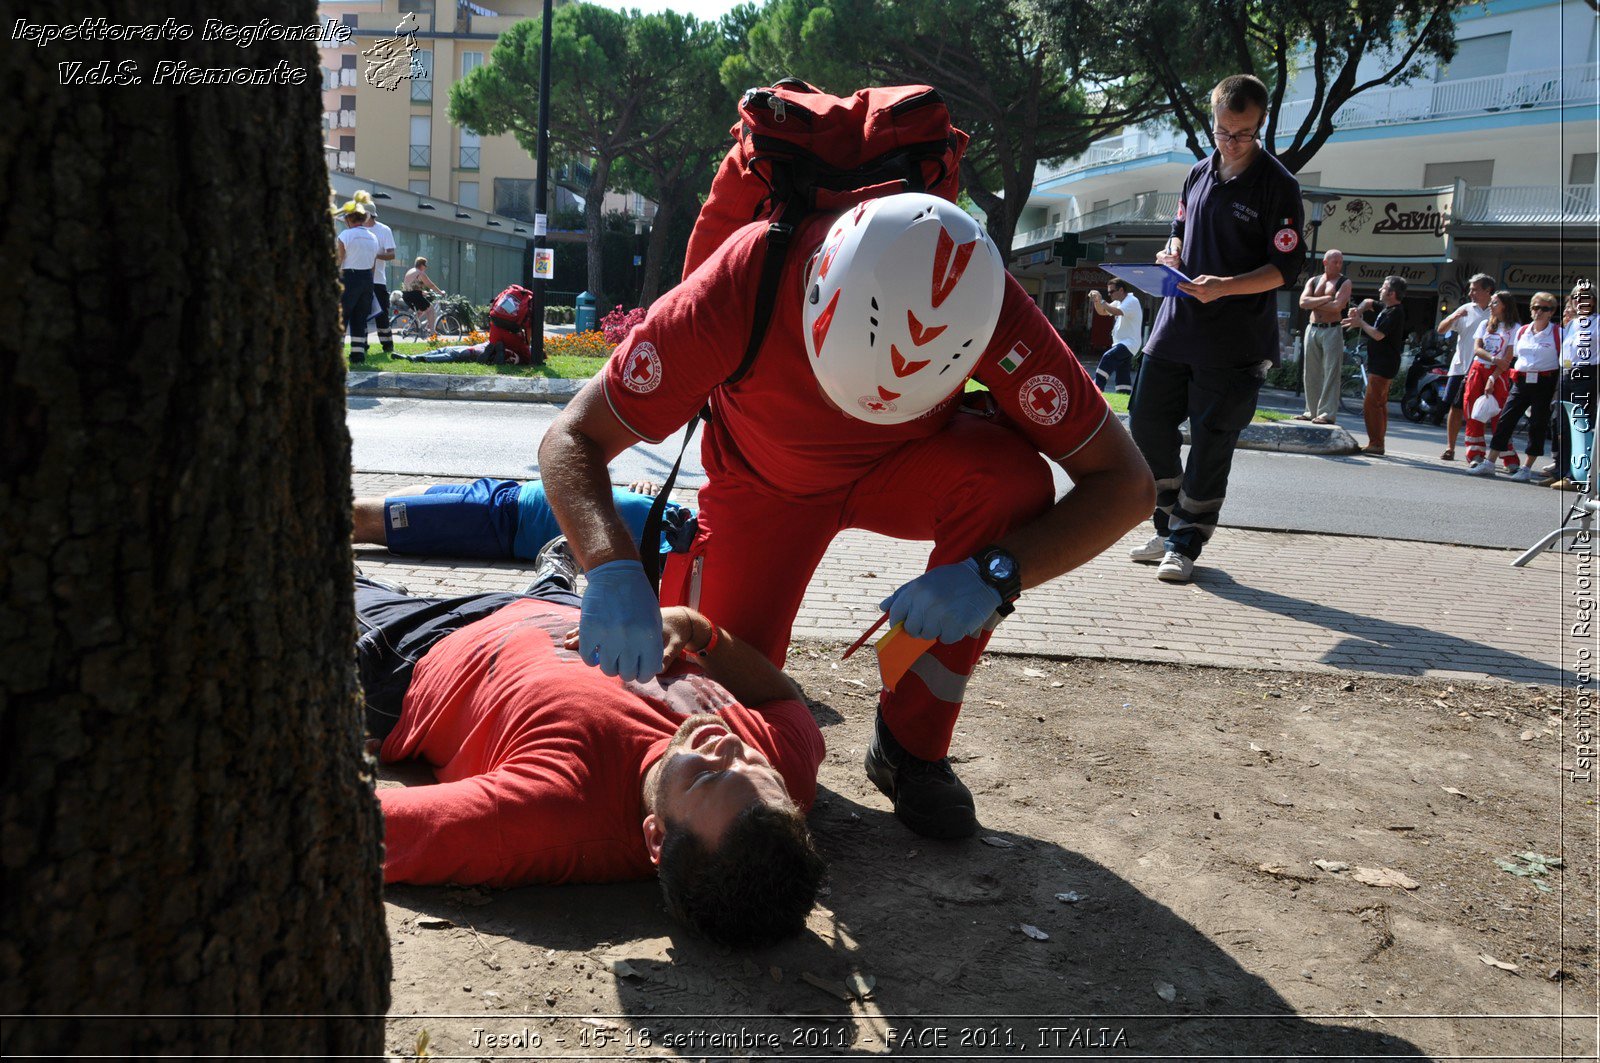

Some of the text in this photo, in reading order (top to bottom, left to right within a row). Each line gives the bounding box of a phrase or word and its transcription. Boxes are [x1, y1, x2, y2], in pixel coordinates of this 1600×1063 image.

[1372, 202, 1450, 237] Savini
[537, 261, 549, 271] 24
[1358, 264, 1426, 280] Snack Bar
[1051, 377, 1068, 402] AGOSTO
